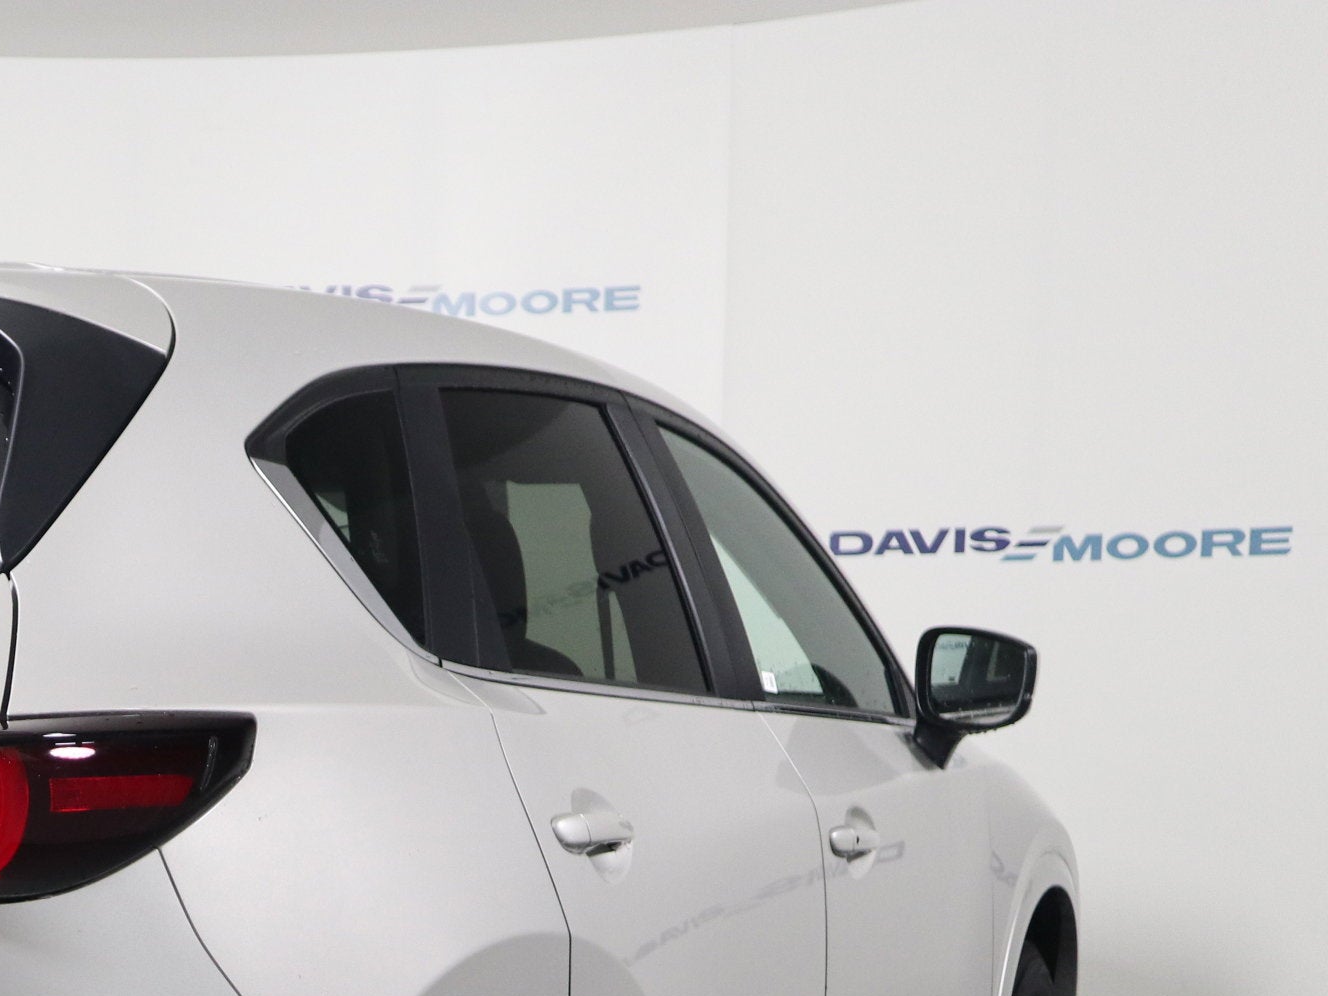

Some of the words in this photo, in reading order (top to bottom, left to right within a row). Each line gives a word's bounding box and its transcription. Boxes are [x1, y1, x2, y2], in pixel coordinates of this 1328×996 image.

[431, 285, 641, 318] MOORE
[828, 526, 1012, 557] DAVIS
[1052, 526, 1293, 562] MOORE
